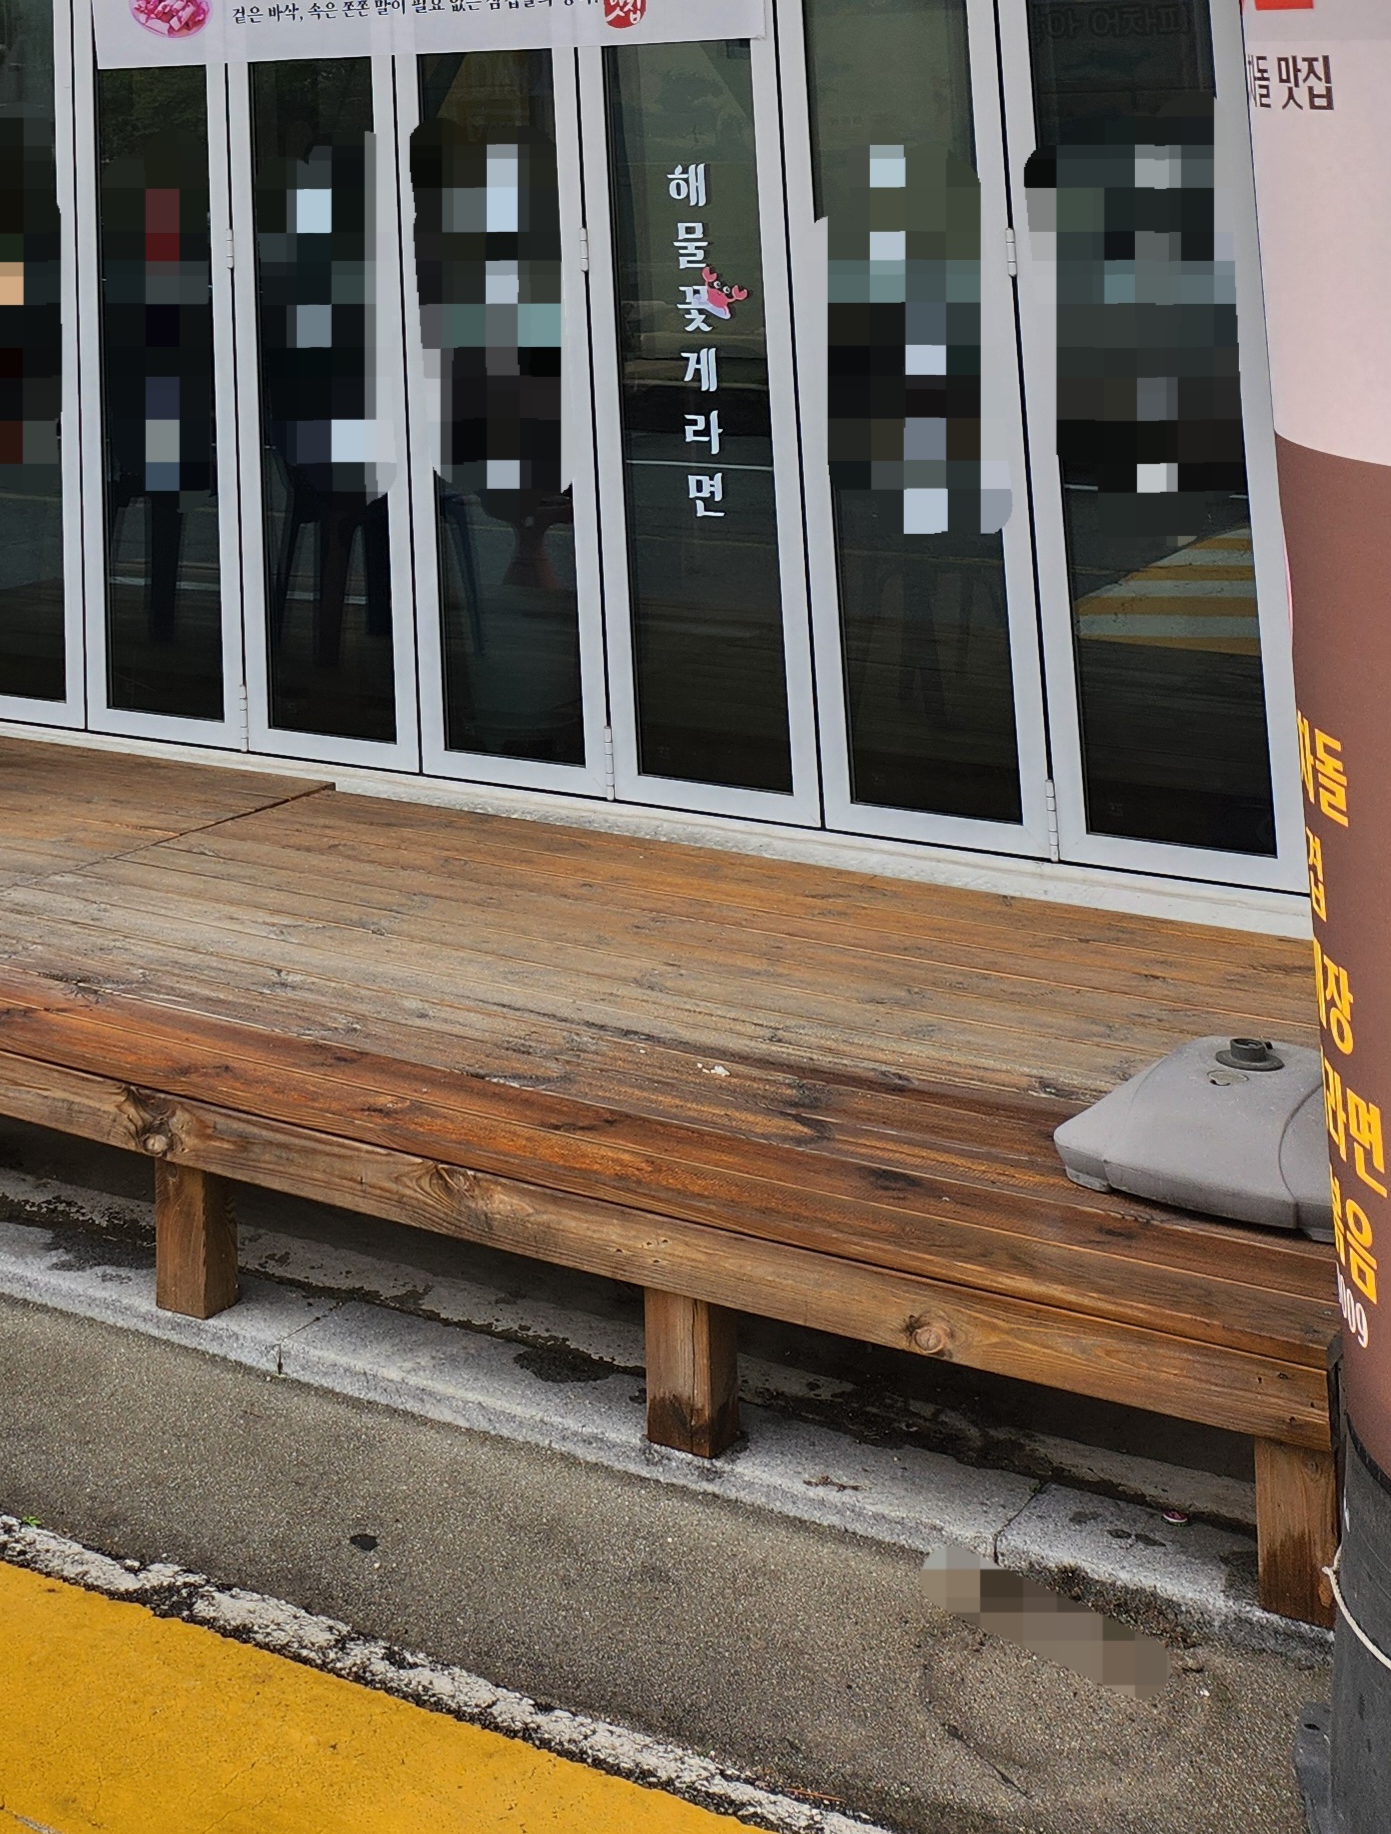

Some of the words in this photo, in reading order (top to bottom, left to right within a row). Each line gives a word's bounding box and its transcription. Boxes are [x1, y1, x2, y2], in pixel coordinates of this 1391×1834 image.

[232, 5, 264, 25] 겉은
[308, 1, 338, 20] 속은
[342, 0, 371, 18] 쫀쫀
[1277, 54, 1335, 111] 맛집
